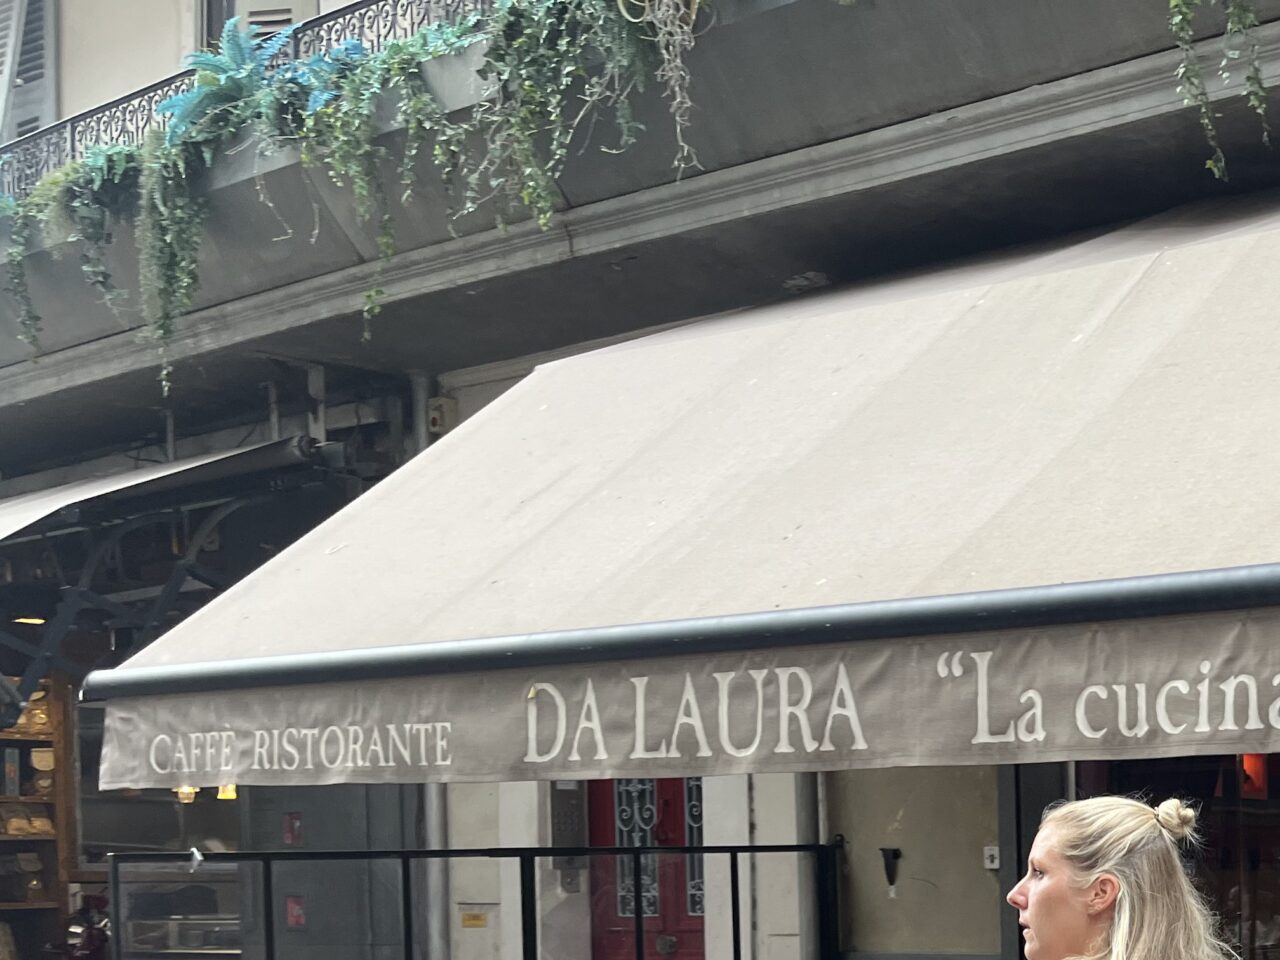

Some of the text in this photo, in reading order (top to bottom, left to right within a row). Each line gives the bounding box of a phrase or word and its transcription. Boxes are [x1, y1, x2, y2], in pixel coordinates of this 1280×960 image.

[523, 661, 869, 763] DA LAURA
[936, 650, 1047, 745] “La
[149, 721, 453, 775] CAFFÈ RISTORANTE
